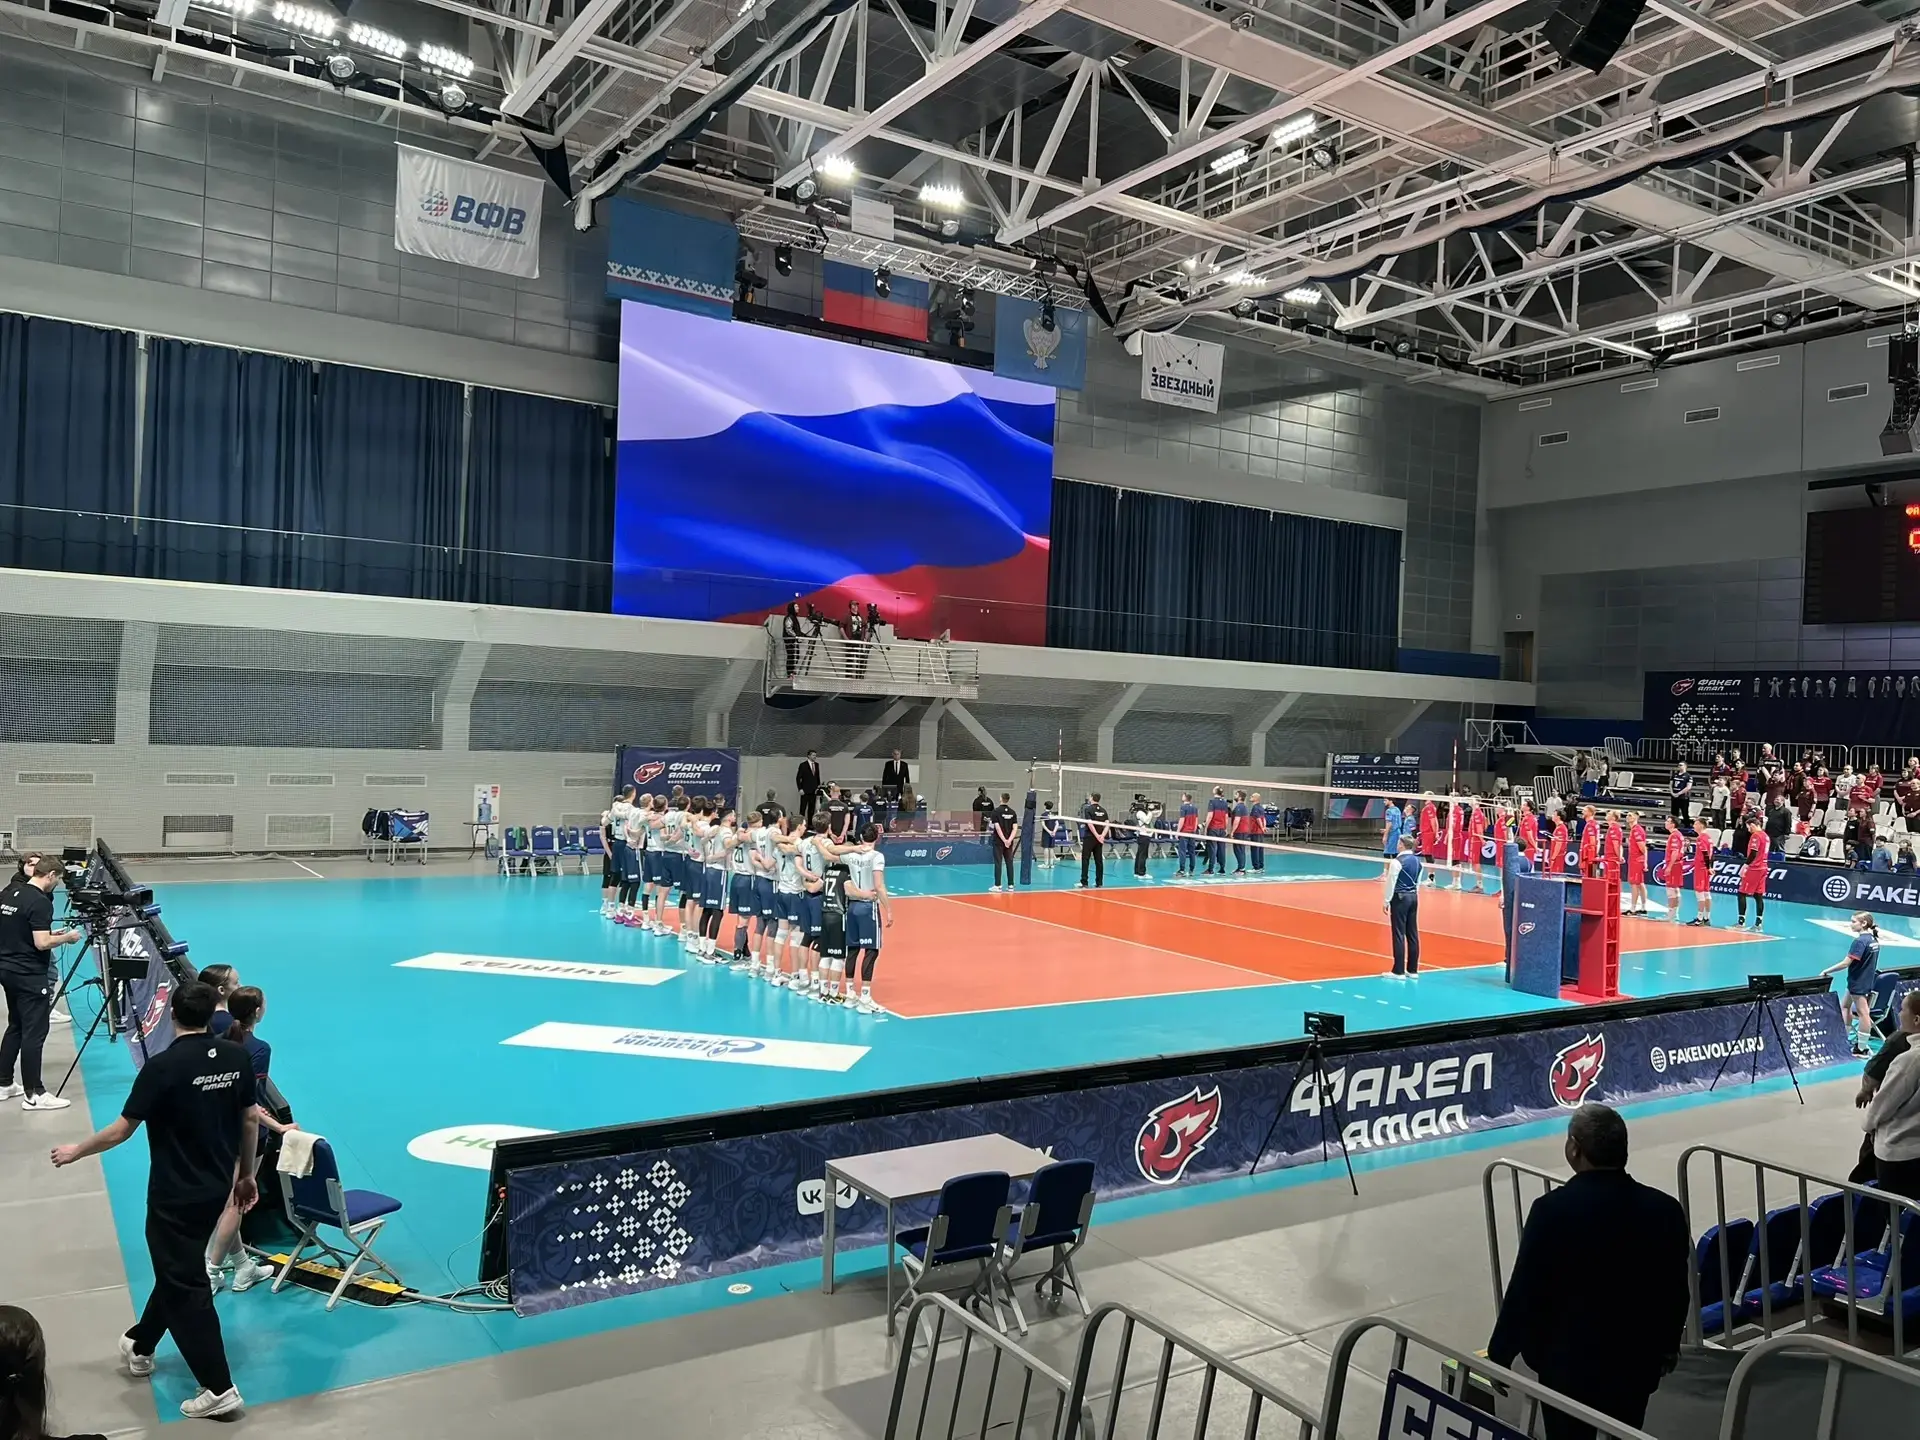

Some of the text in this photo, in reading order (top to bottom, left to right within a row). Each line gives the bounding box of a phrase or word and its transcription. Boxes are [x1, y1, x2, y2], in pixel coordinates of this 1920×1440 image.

[451, 194, 526, 235] ВФВ
[1150, 373, 1214, 398] ЗВЕЗДНЫЙ
[668, 762, 722, 772] ФАКЕЛ
[825, 878, 837, 897] 12
[857, 870, 862, 890] 1
[1856, 883, 1920, 906] FAKE
[1668, 1036, 1764, 1065] FAKELVOLLEY.RU
[192, 1071, 240, 1085] ФАКЕЛ
[202, 1081, 233, 1091] ЯМАЛ
[1290, 1052, 1494, 1117] ФАКЕЛ
[1342, 1104, 1469, 1151] ЯМАЛ
[802, 1188, 823, 1205] VK
